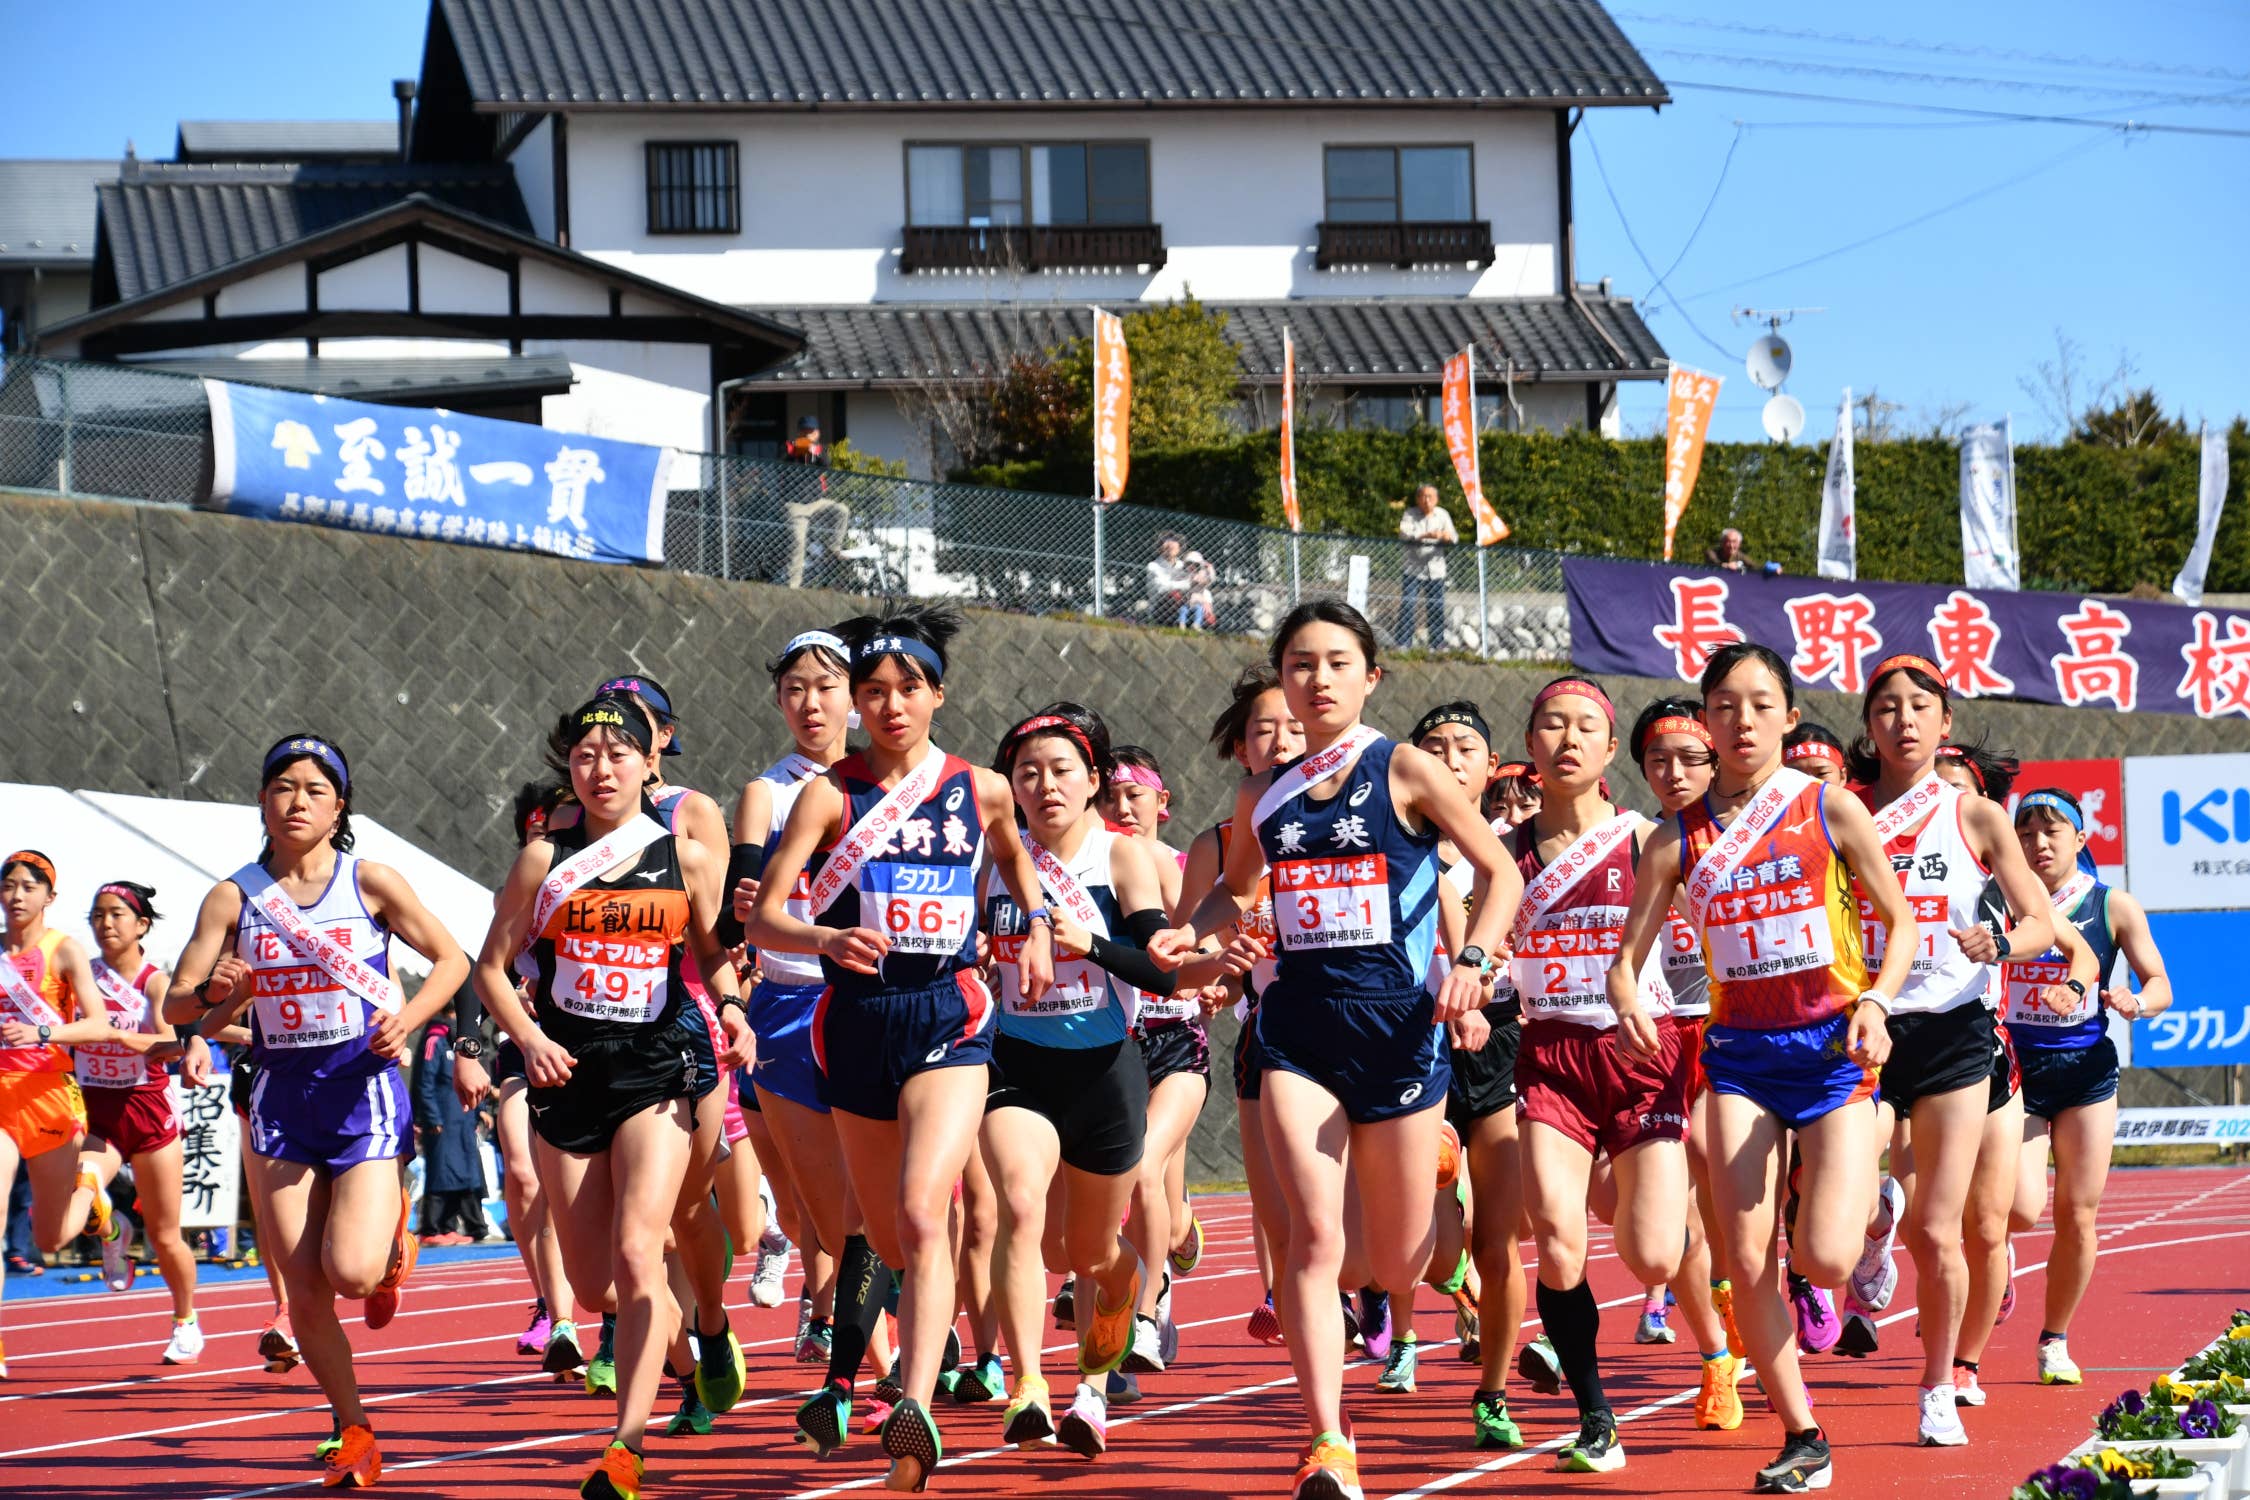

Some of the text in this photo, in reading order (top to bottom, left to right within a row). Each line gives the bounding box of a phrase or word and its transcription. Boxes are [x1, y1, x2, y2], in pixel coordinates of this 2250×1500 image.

[333, 416, 606, 531] 至誠一貫
[1653, 576, 2250, 719] 長野東高校
[581, 710, 624, 726] 比叡山
[1274, 815, 1371, 855] 薫英
[895, 866, 955, 893] タカノ
[1278, 859, 1376, 888] ハナマルキ
[1710, 880, 1814, 921] ハナマルキ
[565, 901, 665, 933] 比叡山
[564, 937, 665, 964] ハナマルキ
[1668, 953, 1703, 967] 春の高
[1726, 951, 1819, 979] 春の高校伊那駅伝
[563, 998, 652, 1018] 春の高校伊那駅伝
[267, 1025, 351, 1045] 春の高校伊那駅伝
[2148, 1006, 2250, 1050] タカノ
[181, 1085, 225, 1215] 招集所
